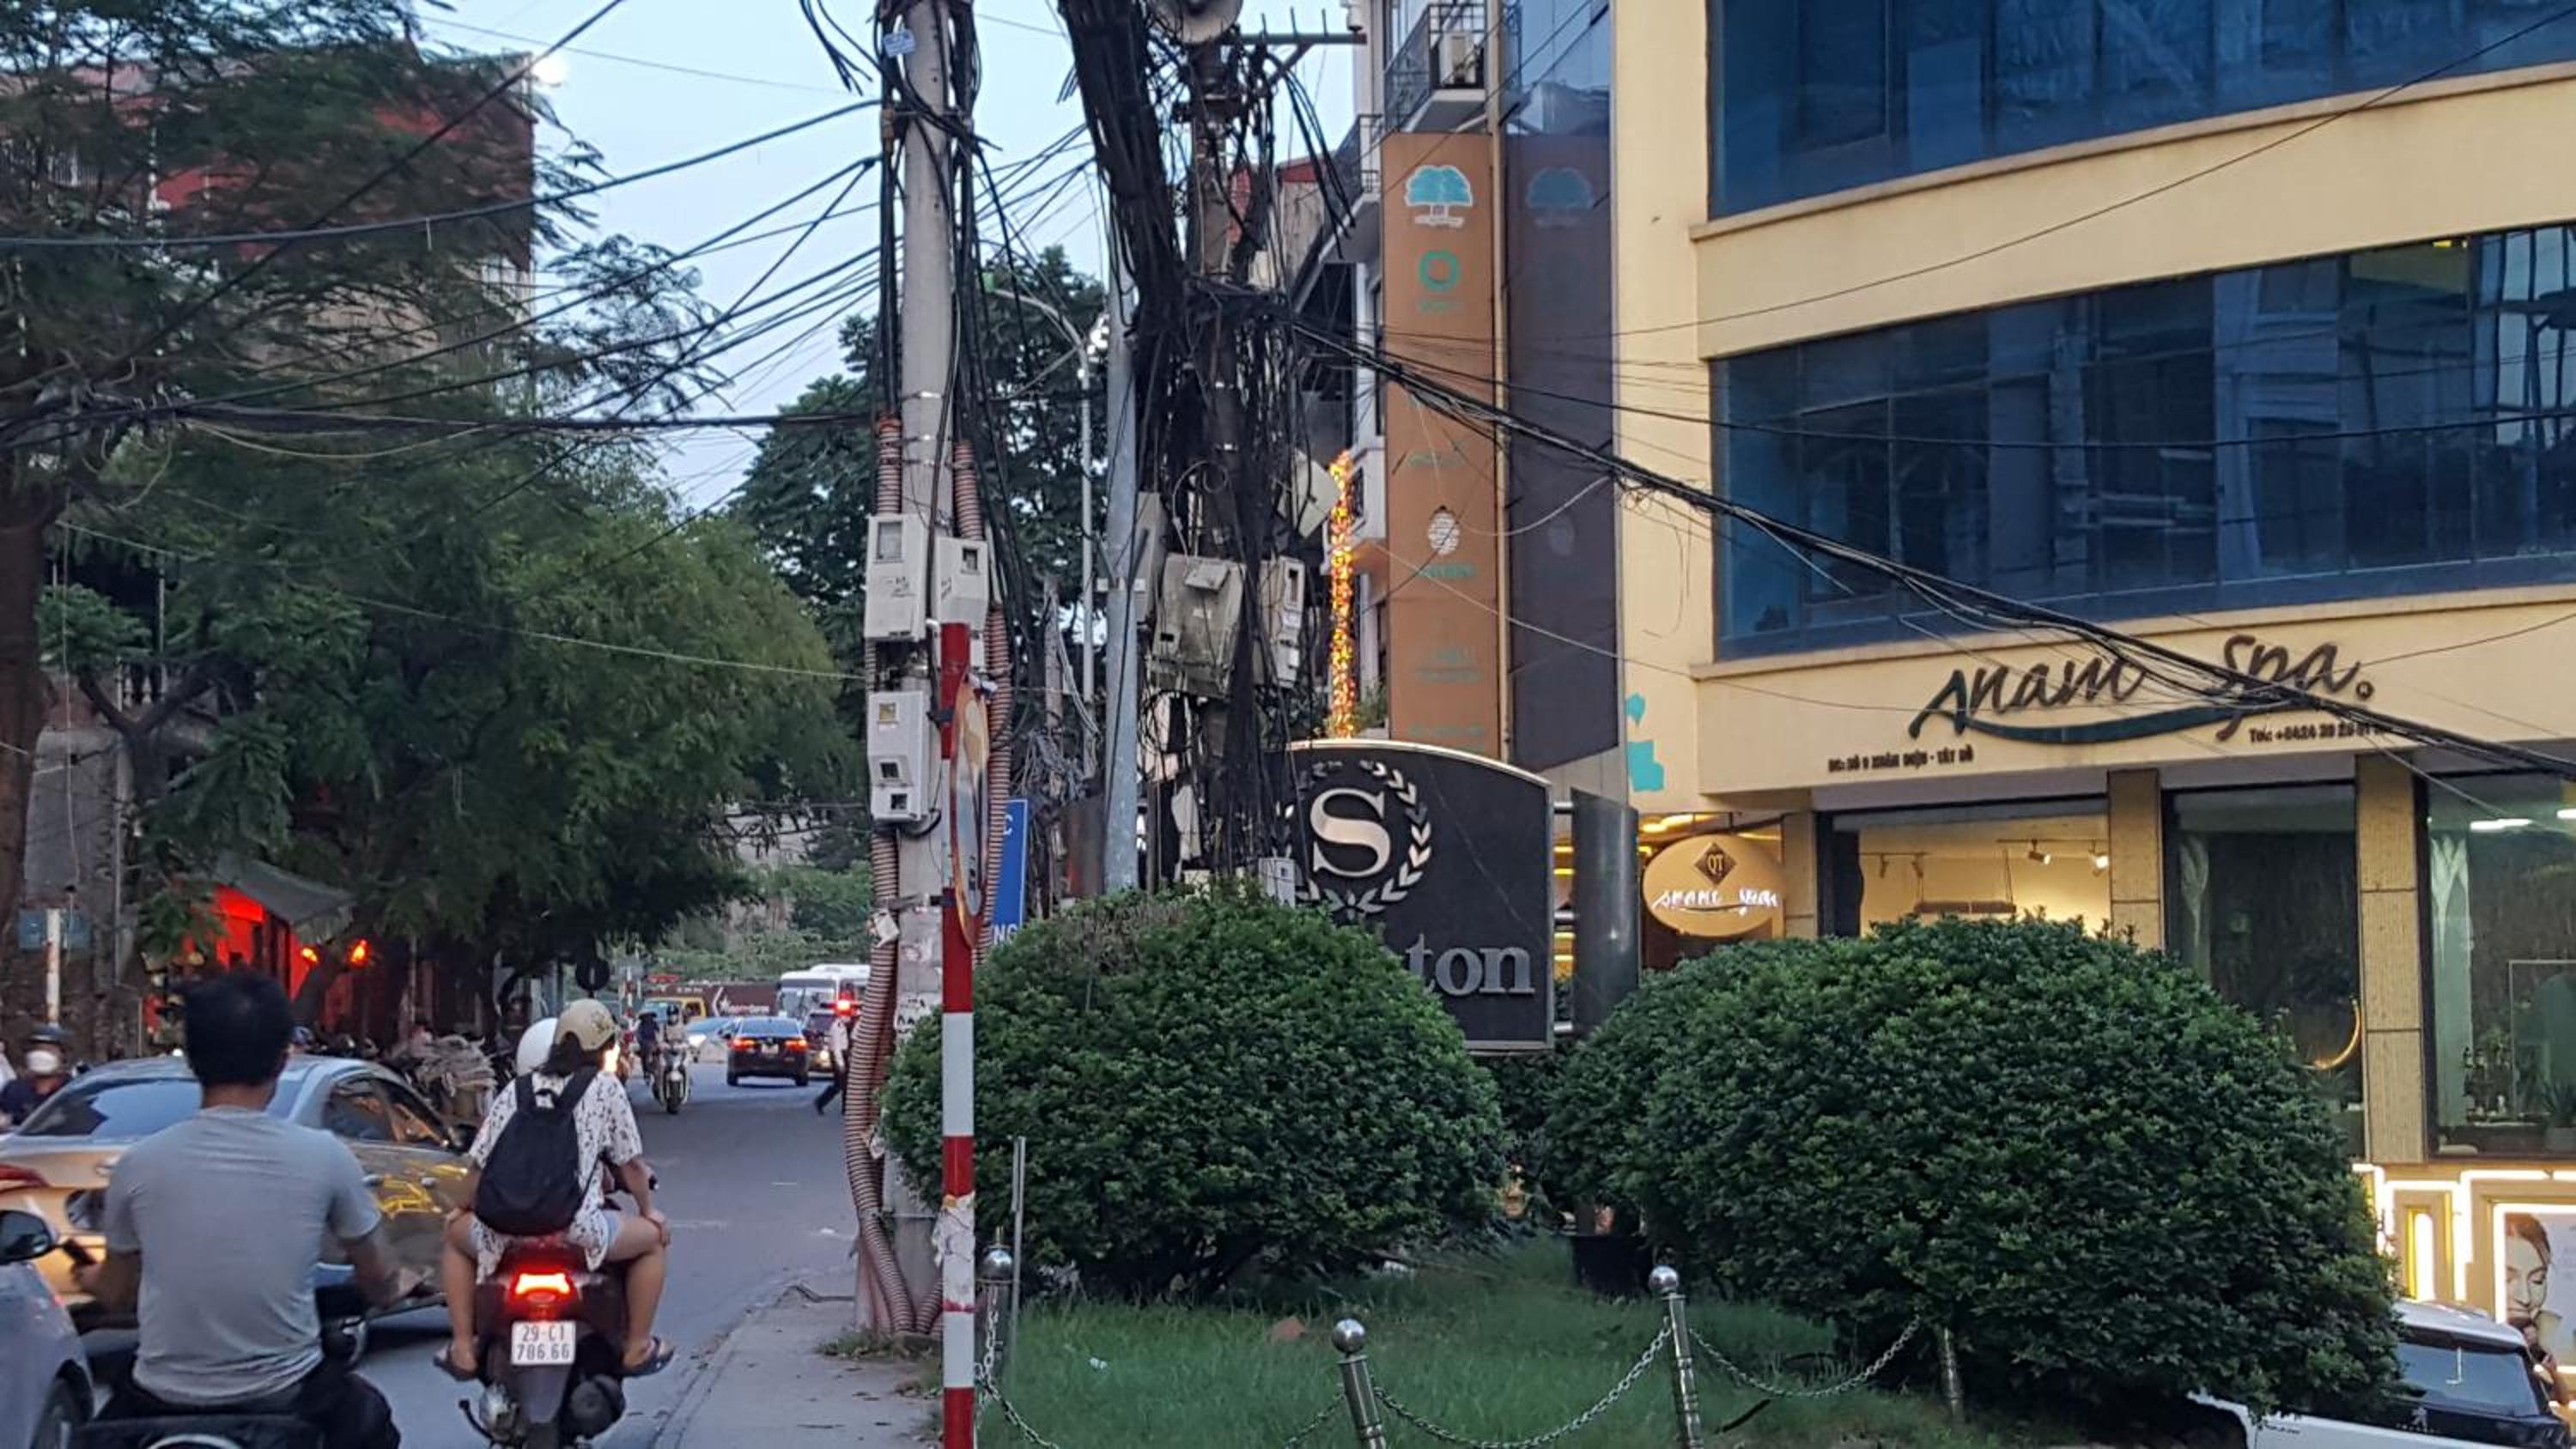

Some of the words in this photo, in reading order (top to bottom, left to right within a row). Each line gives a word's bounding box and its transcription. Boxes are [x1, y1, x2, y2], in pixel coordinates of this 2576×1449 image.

[1908, 654, 2147, 738] Anam
[2215, 634, 2361, 741] Spa
[1310, 788, 1390, 877] S
[1406, 933, 1535, 997] ton
